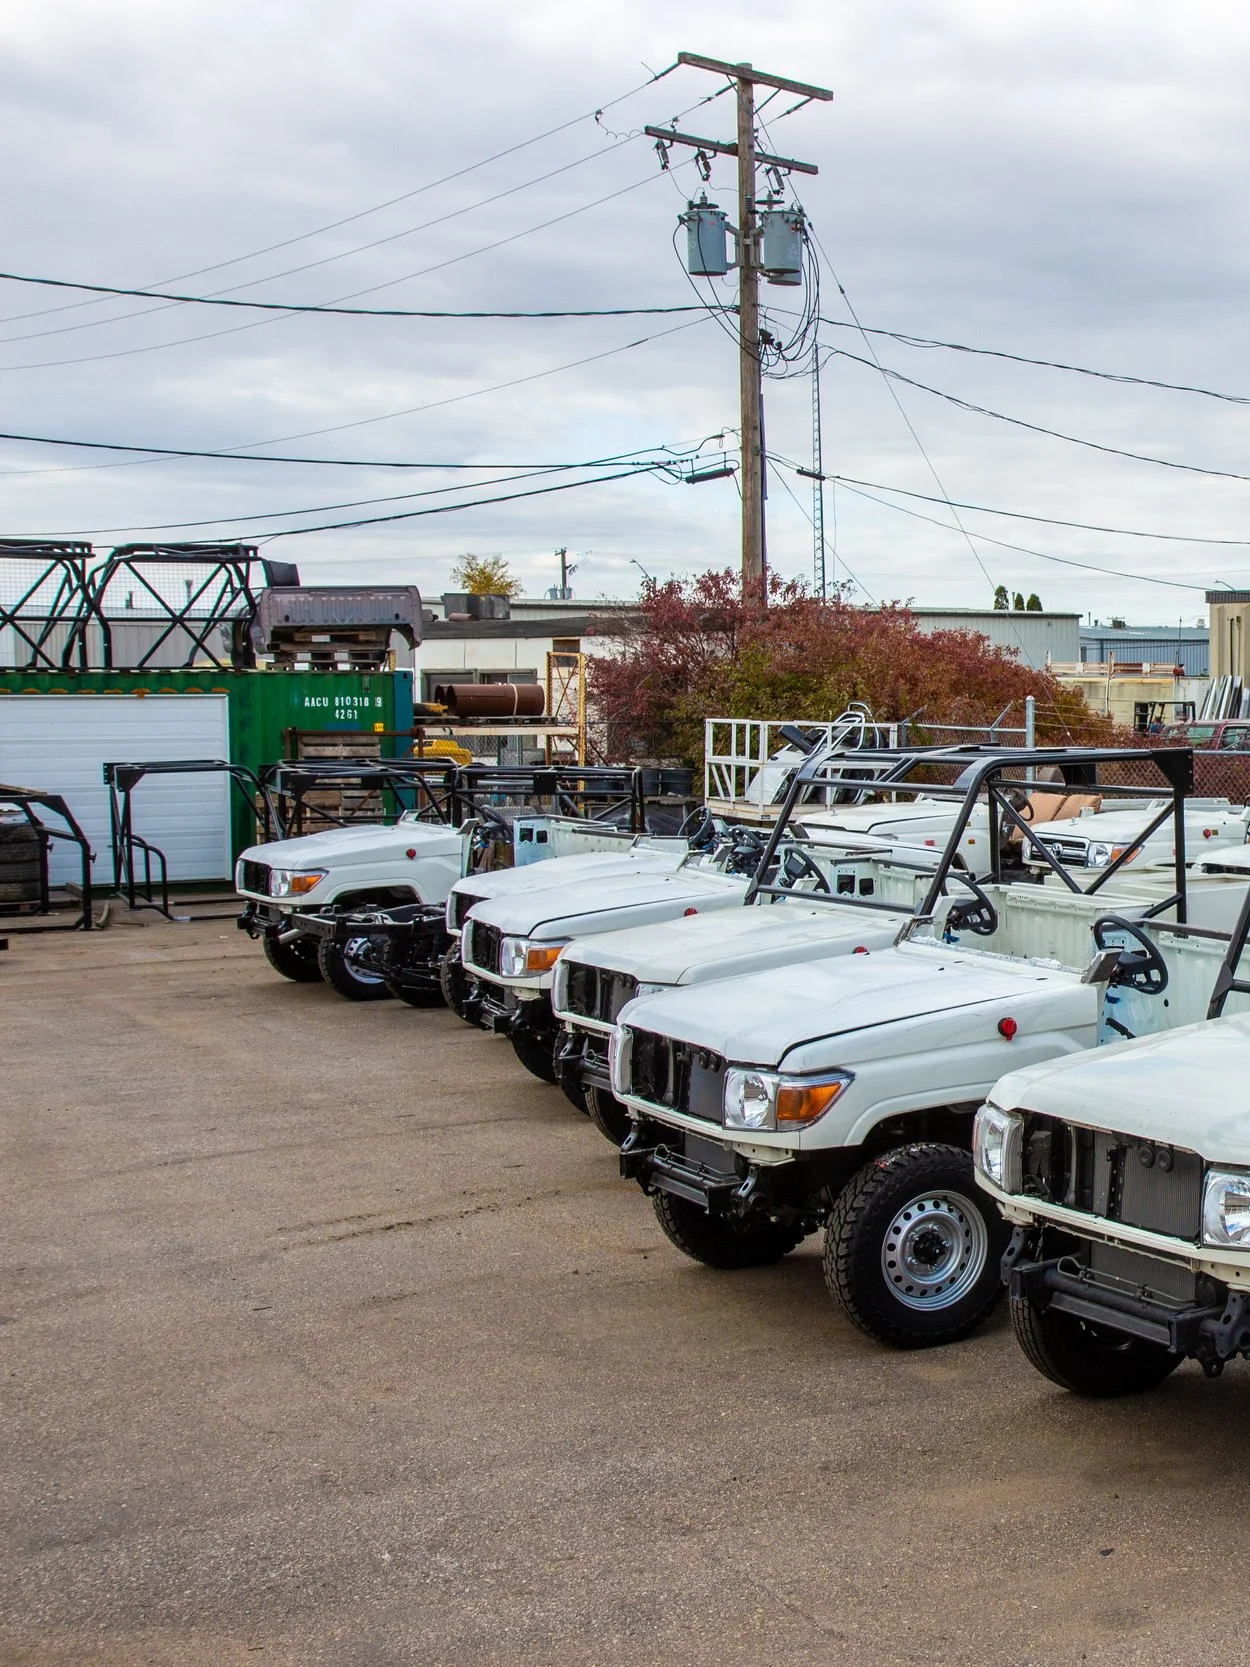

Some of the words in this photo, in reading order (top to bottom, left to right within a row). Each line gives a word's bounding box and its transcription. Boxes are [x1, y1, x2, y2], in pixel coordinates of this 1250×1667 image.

[304, 697, 328, 707] AACU
[334, 696, 369, 707] 810318
[375, 697, 382, 707] 9
